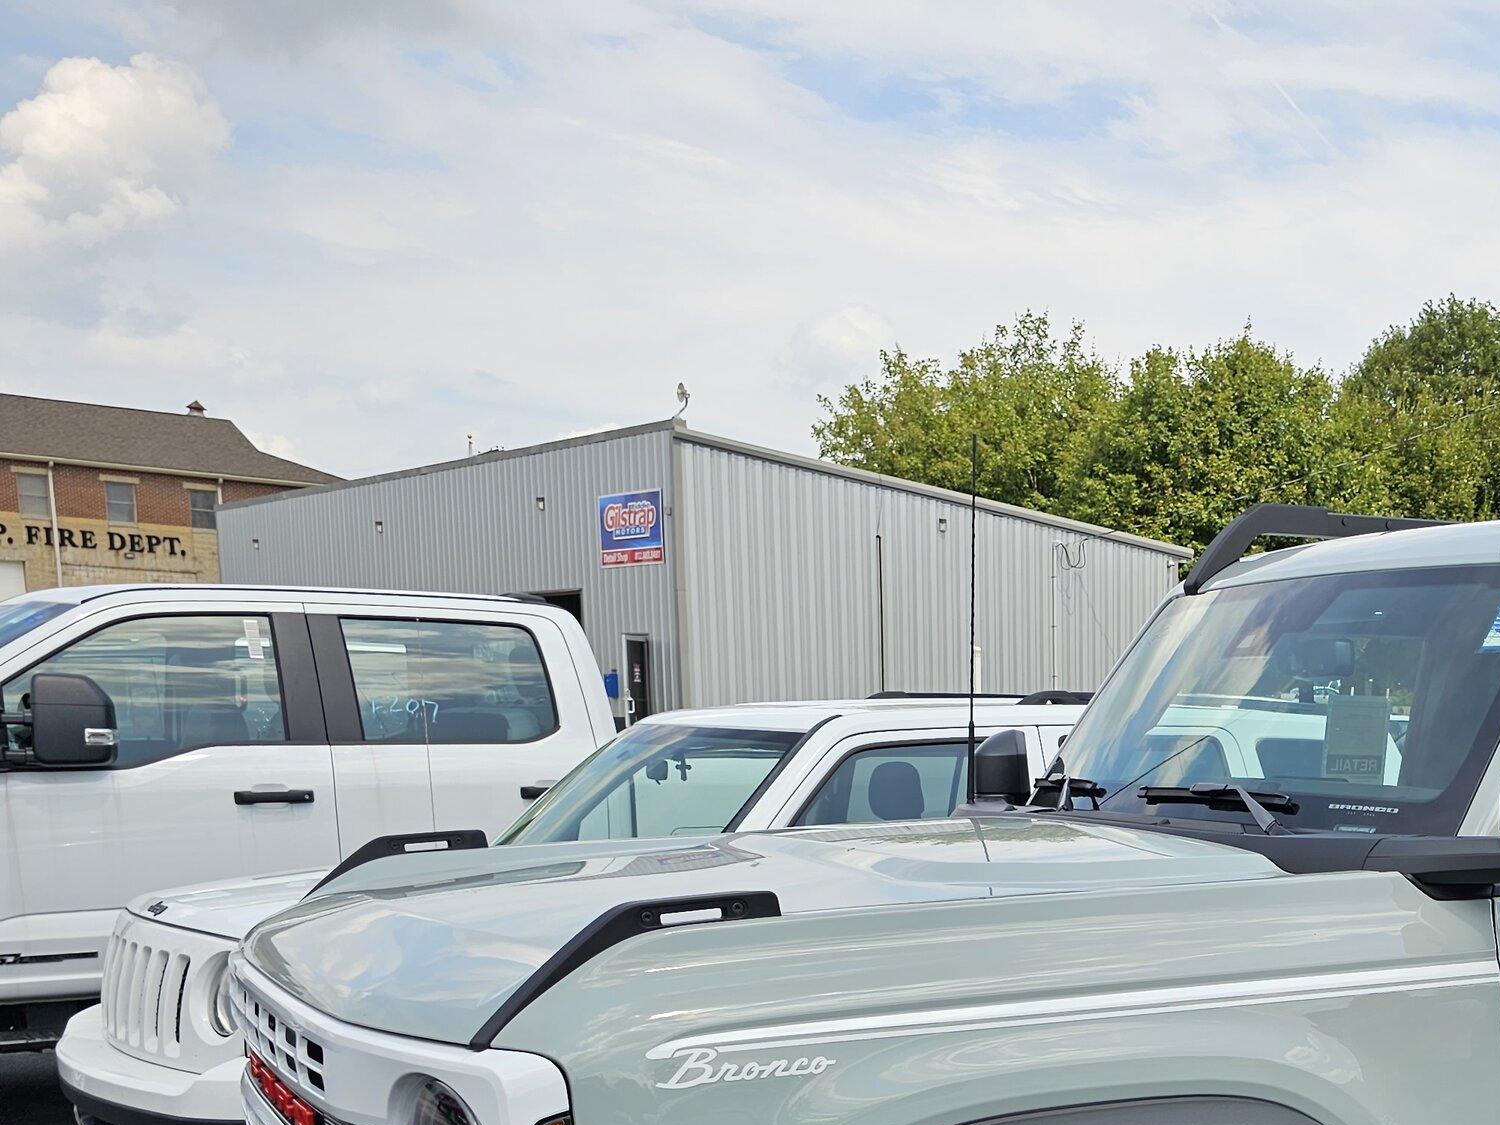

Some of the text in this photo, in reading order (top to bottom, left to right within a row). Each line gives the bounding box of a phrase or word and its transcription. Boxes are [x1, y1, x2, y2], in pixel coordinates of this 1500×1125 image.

[605, 505, 655, 530] Gilstrap
[26, 525, 97, 549] FIRE
[107, 531, 186, 557] DEPT.
[615, 528, 645, 536] MOTORS
[1328, 803, 1399, 814] BRONCO
[655, 1047, 837, 1090] Bronco
